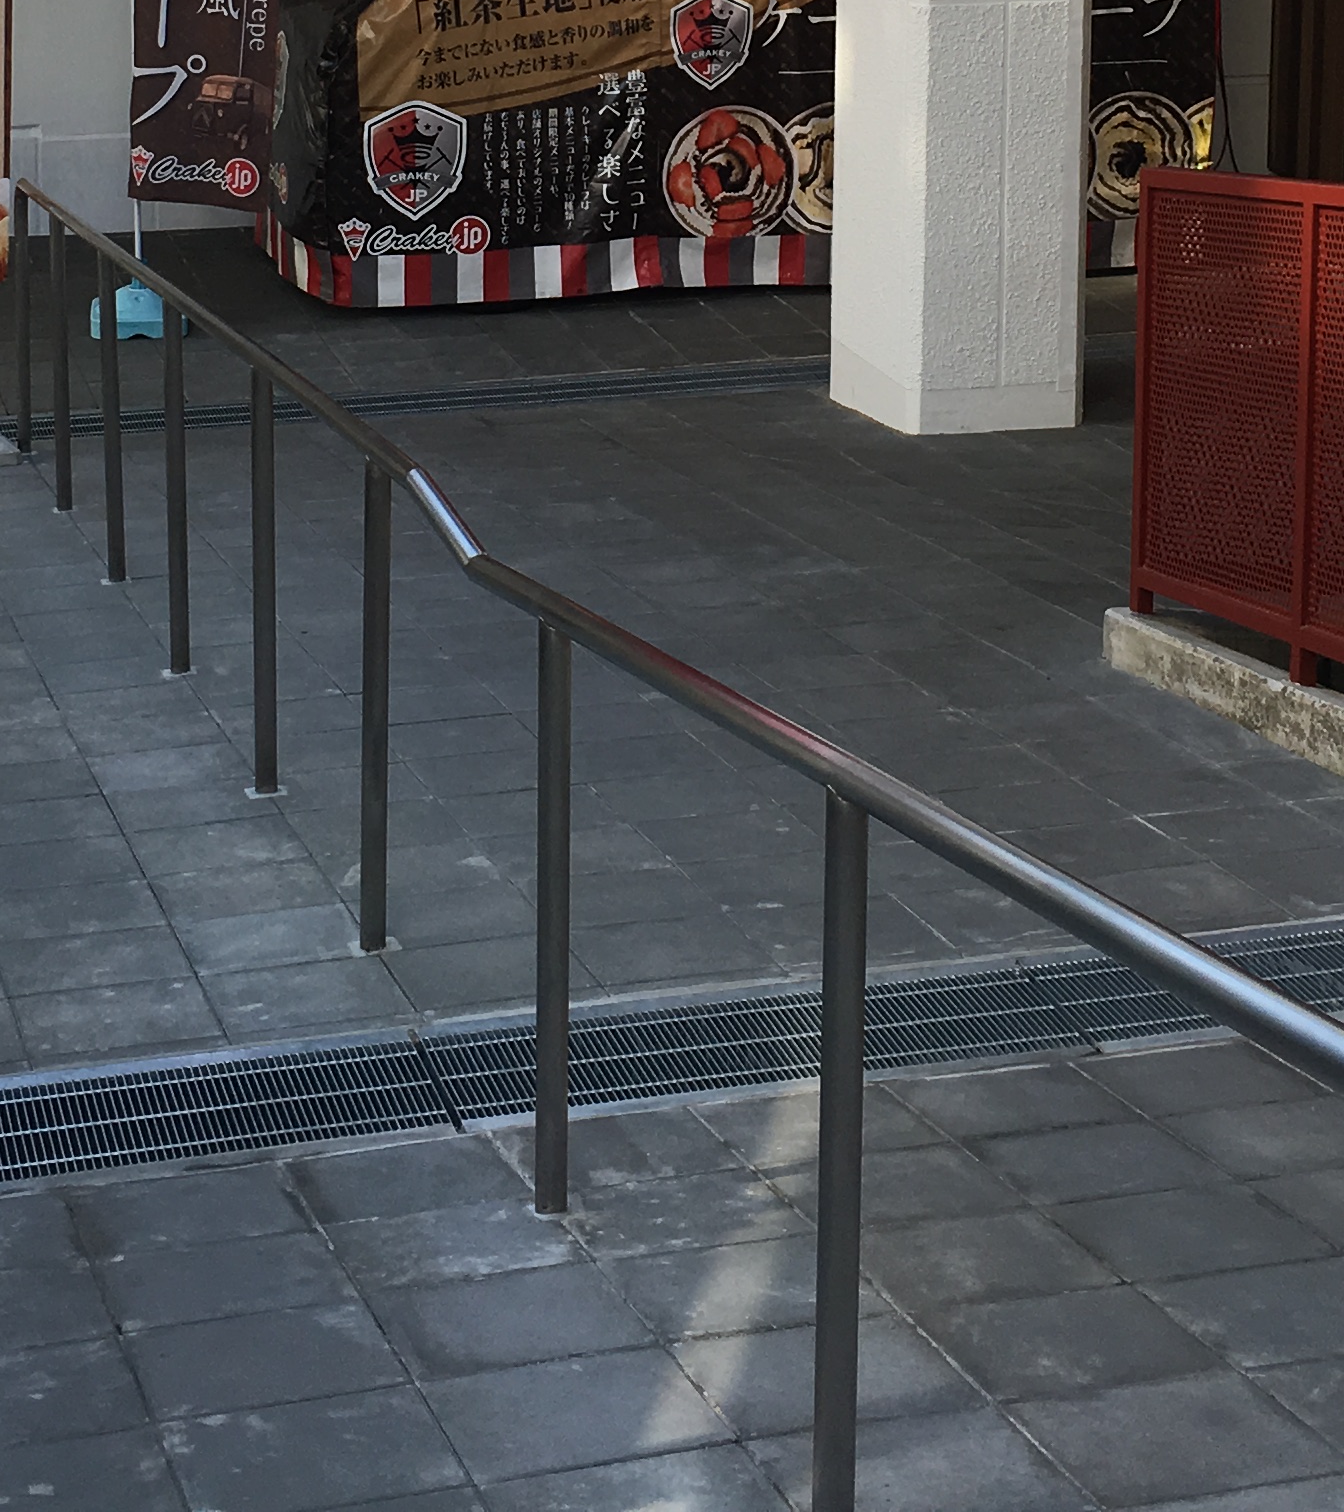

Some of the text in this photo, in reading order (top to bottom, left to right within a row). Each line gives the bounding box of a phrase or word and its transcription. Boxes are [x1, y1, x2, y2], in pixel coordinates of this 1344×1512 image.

[691, 49, 733, 60] CRAKEY
[702, 63, 722, 75] JP
[597, 72, 622, 232] 選べる楽しさ
[624, 68, 648, 230] 豊富なメニュー
[389, 171, 441, 183] CRAKEY
[404, 189, 428, 202] JP
[367, 221, 483, 255] Crakey jp
